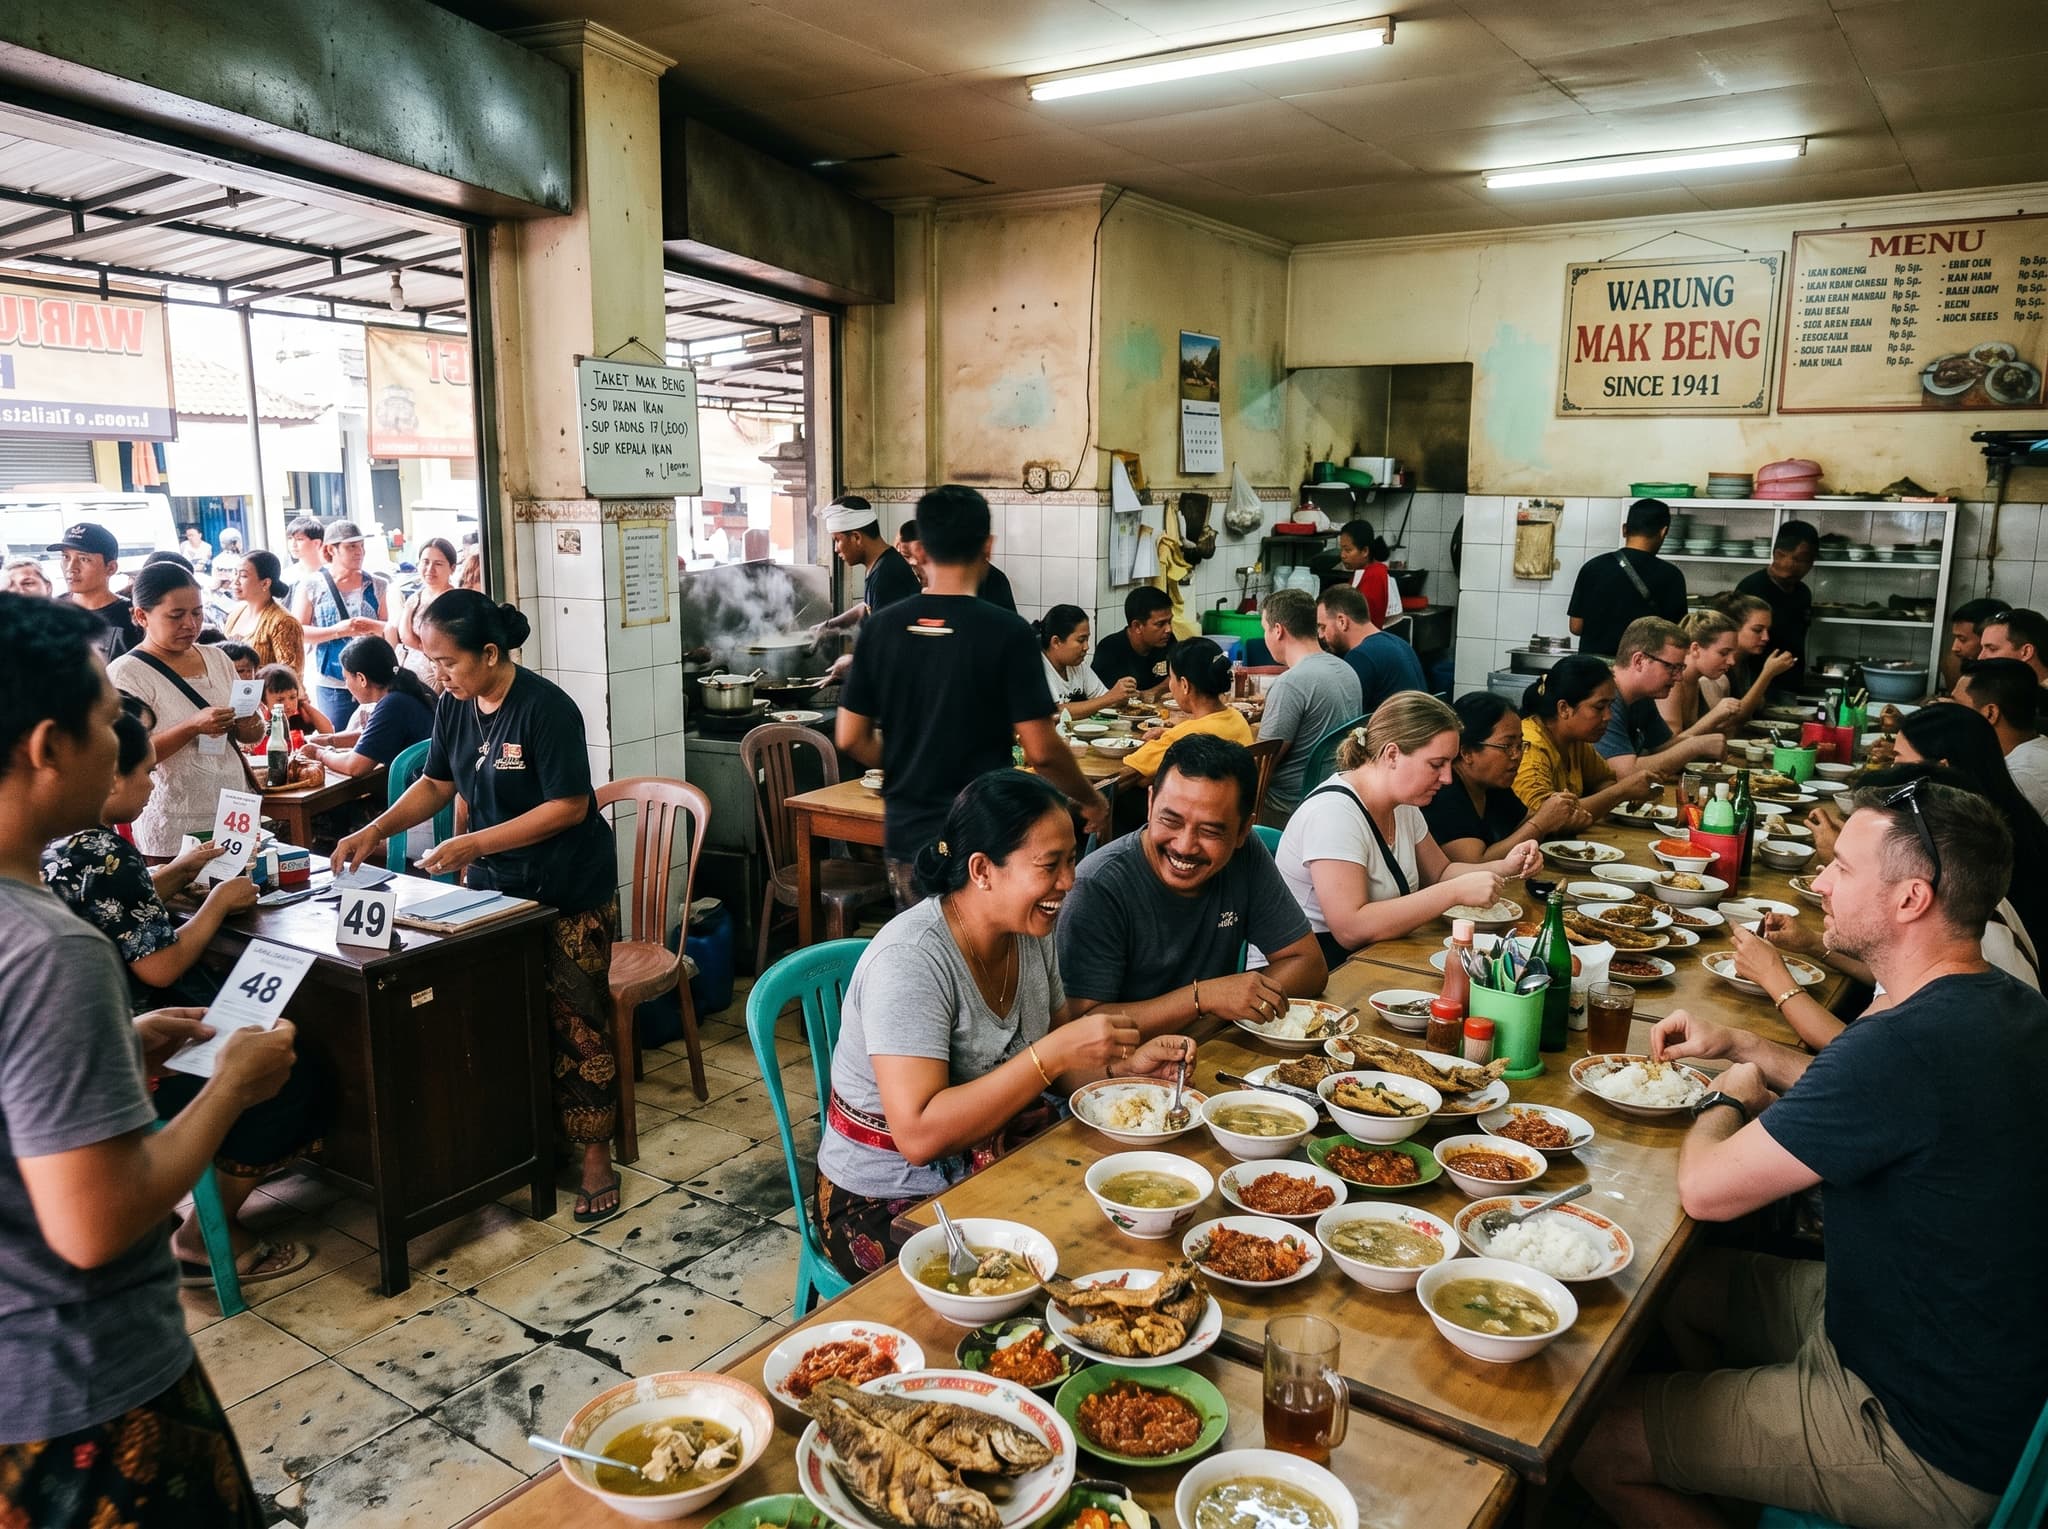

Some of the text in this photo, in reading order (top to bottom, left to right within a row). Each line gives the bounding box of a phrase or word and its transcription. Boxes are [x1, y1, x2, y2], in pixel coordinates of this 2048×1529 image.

[1868, 229, 1986, 258] MENU
[1607, 275, 1735, 311] WARUNG
[1575, 318, 1760, 363] MAK BENG
[593, 370, 685, 392] TAKET MAK BENG
[1603, 374, 1720, 397] SINCE 1941
[643, 400, 663, 414] IKAN
[592, 421, 610, 433] SUP
[592, 442, 672, 456] SUP KEPALA IKAN
[223, 811, 251, 833] 48
[220, 838, 242, 855] 49
[343, 899, 386, 938] 49
[239, 972, 283, 1003] 48
